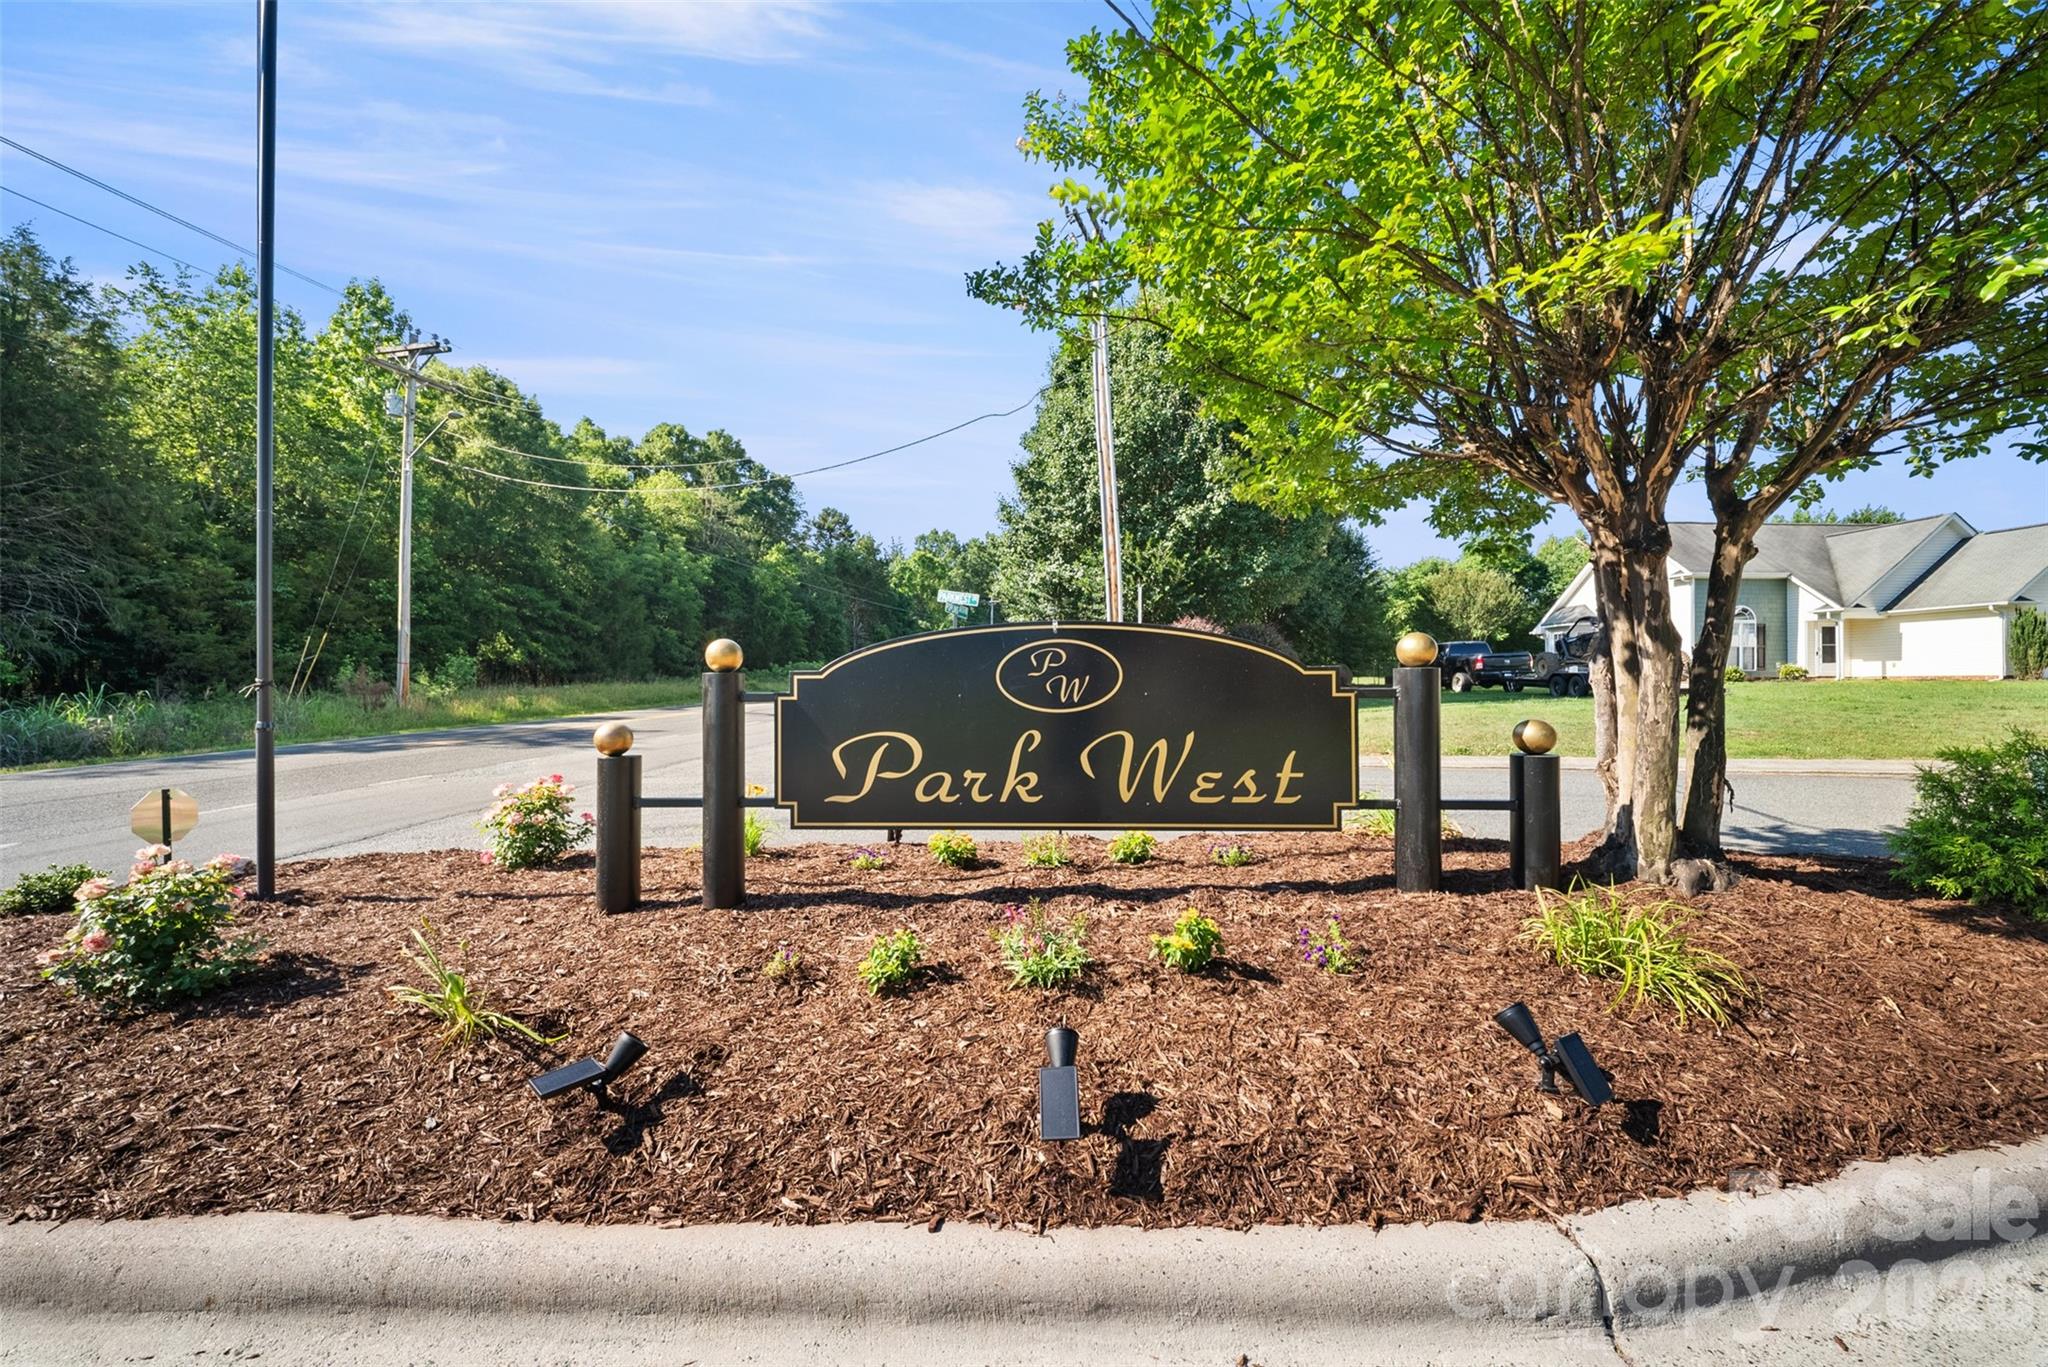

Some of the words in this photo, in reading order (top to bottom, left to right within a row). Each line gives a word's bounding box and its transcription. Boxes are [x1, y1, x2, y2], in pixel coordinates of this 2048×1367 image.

[1028, 647, 1067, 676] P
[1046, 674, 1090, 704] W
[824, 729, 1043, 803] Park
[1079, 730, 1304, 804] West
